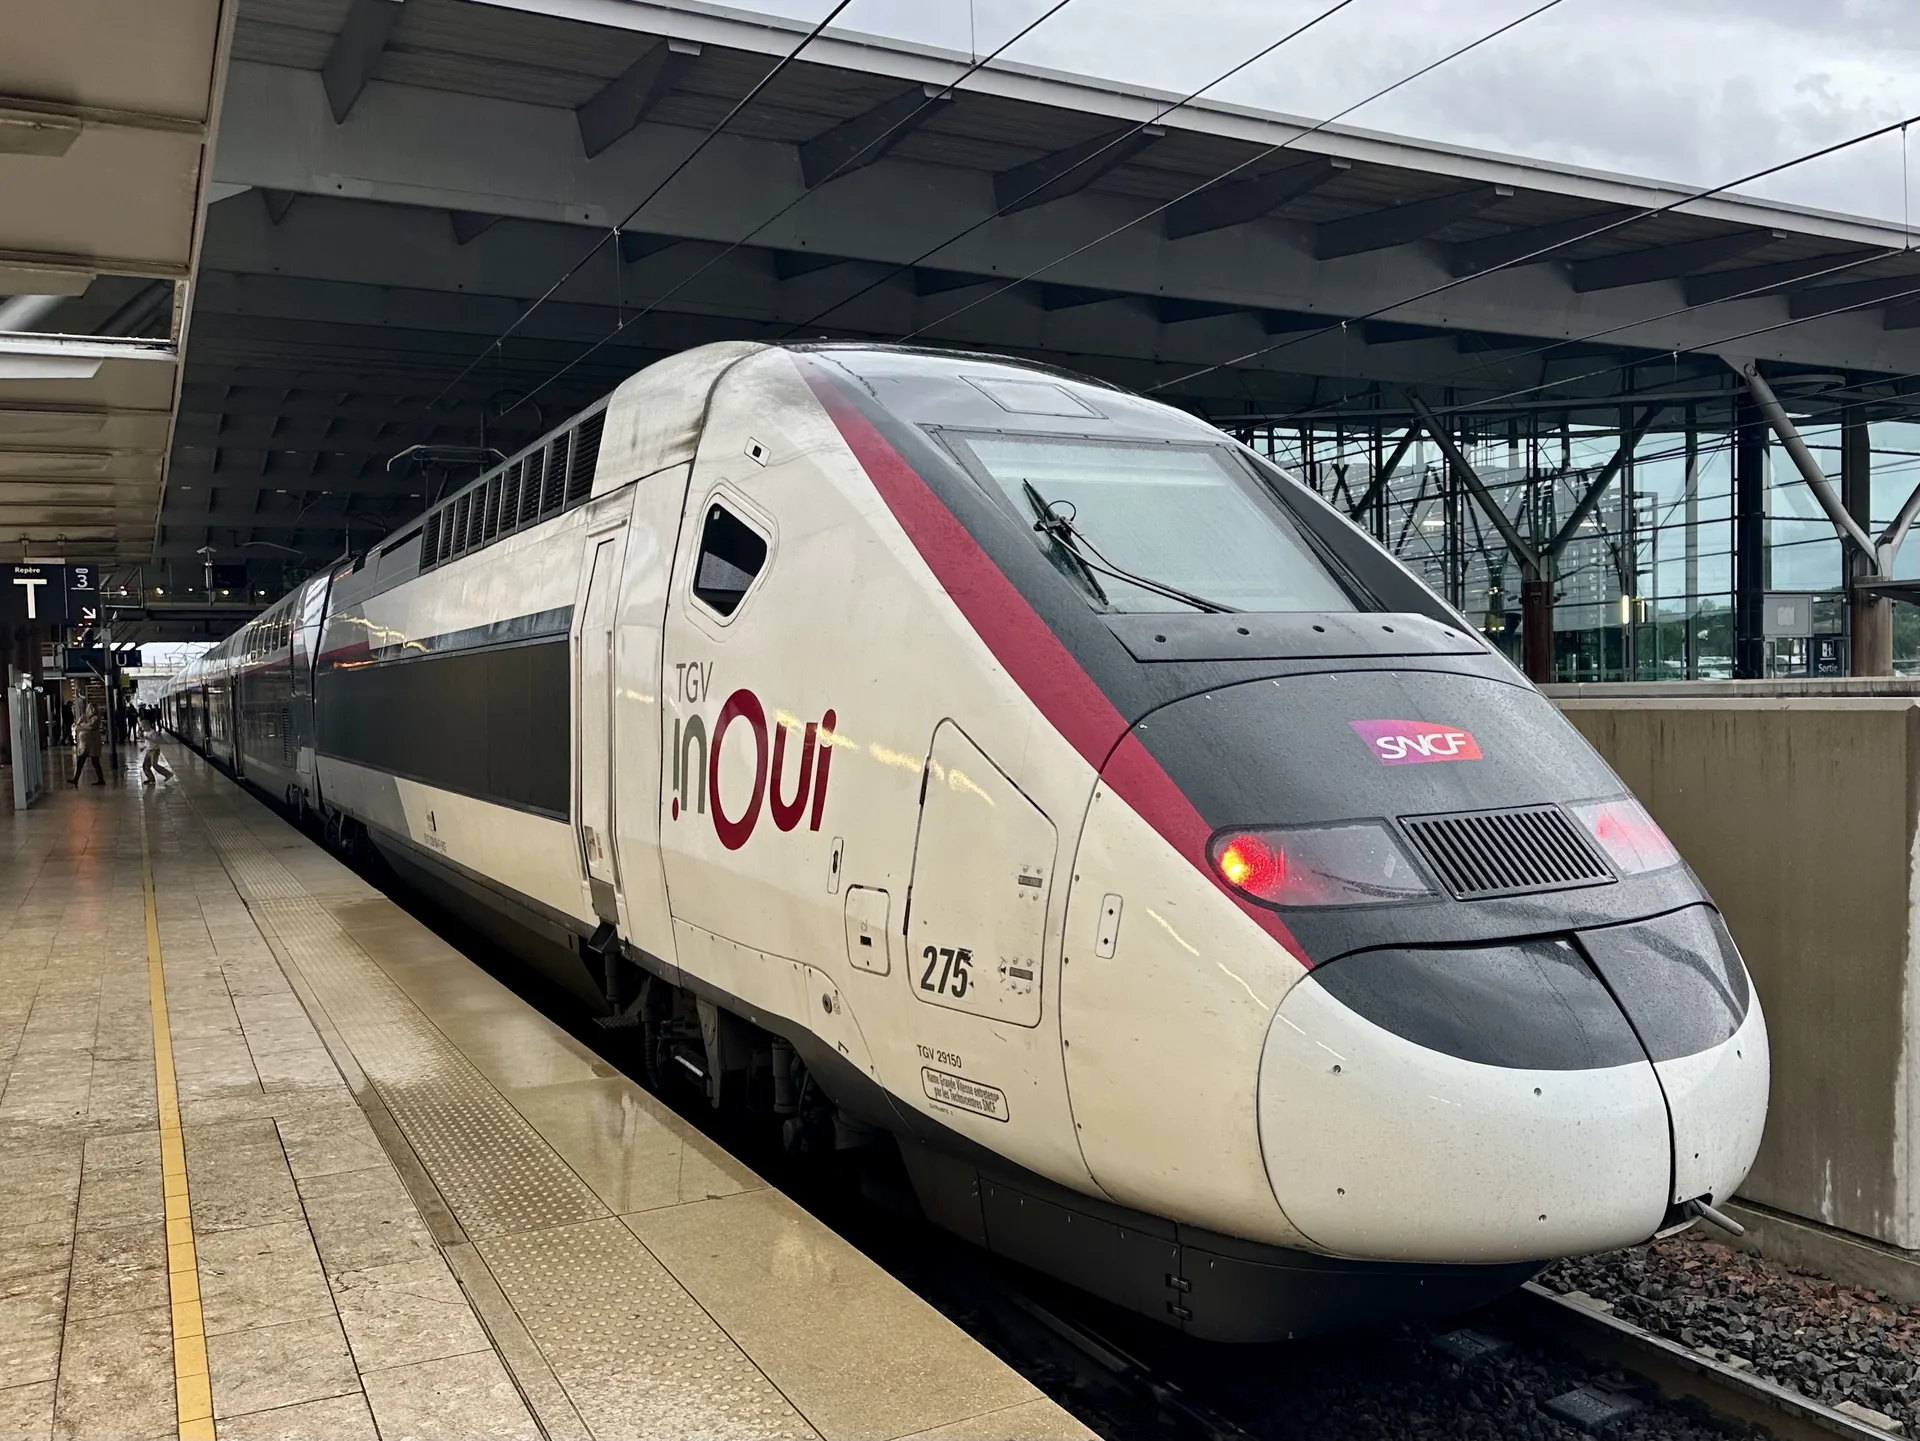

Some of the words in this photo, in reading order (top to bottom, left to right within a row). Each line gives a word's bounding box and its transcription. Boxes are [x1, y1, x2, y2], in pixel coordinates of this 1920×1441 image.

[14, 566, 41, 575] Repère
[77, 574, 88, 588] 3
[13, 578, 47, 619] T
[116, 653, 127, 666] U
[1818, 663, 1838, 673] Sortie
[676, 661, 713, 703] TGV
[1376, 733, 1466, 759] SNCF
[920, 945, 971, 998] 275
[916, 1044, 934, 1060] TGV
[937, 1050, 962, 1068] 29150
[939, 1073, 956, 1090] Grande
[956, 1079, 973, 1095] Vitesse
[942, 1086, 950, 1100] les
[982, 1099, 995, 1113] SNCF
